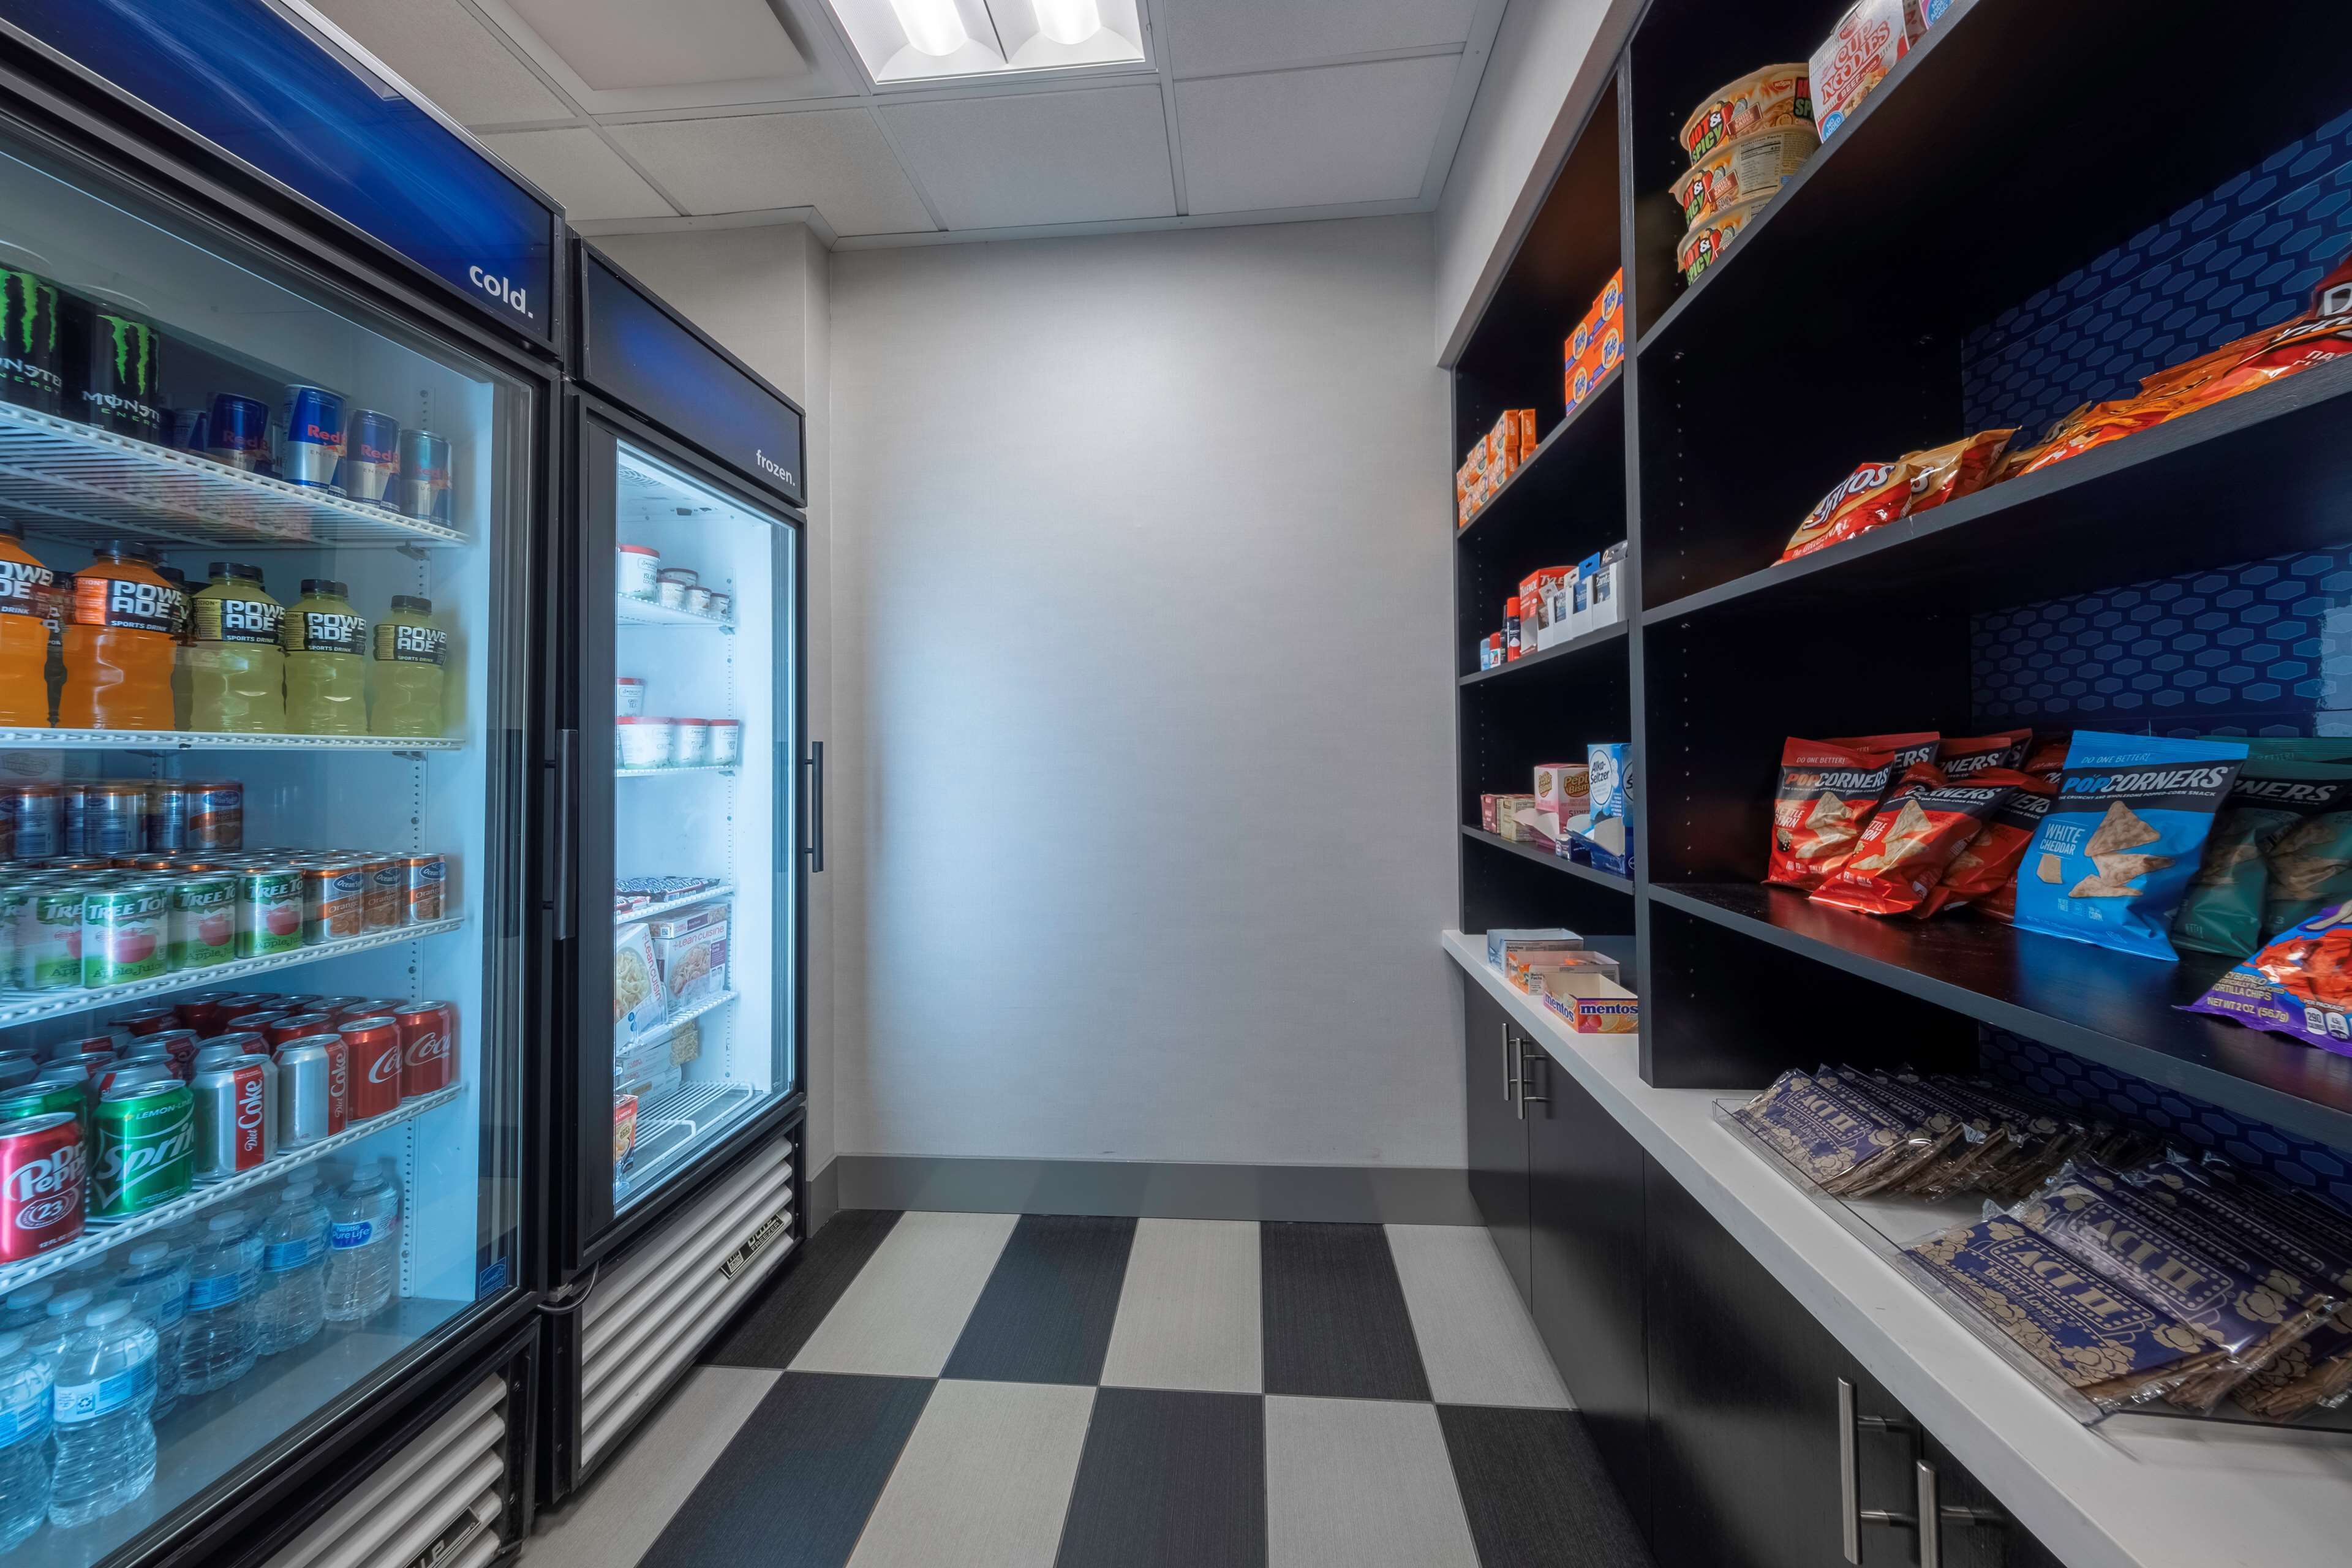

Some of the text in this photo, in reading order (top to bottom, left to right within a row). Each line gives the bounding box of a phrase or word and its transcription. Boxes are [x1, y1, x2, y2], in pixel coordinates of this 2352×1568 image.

[1834, 19, 1872, 69] CUP
[1822, 20, 1890, 105] NOODLES
[1841, 75, 1863, 97] BEEF
[1689, 112, 1722, 151] HOT &
[1826, 118, 1834, 129] NO
[1692, 124, 1722, 164] SPICY
[1683, 181, 1703, 211] OT &
[1700, 238, 1711, 252] &
[469, 265, 533, 318] cold.
[1604, 289, 1617, 317] Tide
[1575, 331, 1586, 355] Tide
[1604, 337, 1618, 364] Tide
[1575, 375, 1586, 398] Tide
[81, 390, 160, 423] MONST
[756, 449, 796, 486] frozen.
[1803, 465, 1896, 530] Fritos
[1540, 575, 1564, 585] TYLE
[1596, 574, 1611, 587] Zanta
[114, 579, 182, 606] POWE
[112, 596, 170, 619] ADE
[226, 599, 285, 620] POWE
[111, 620, 145, 629] SPORTS
[226, 614, 275, 631] ADE
[309, 625, 353, 641] ADE
[398, 638, 435, 652] ADE
[1592, 761, 1606, 771] Alka-
[2116, 753, 2151, 763] BETTER!
[1564, 772, 1589, 788] Pept
[1569, 783, 1589, 794] Bism
[1591, 771, 1610, 785] Seltzer
[1785, 767, 1889, 788] POPCORNERS
[2061, 766, 2229, 794] POPCORNERS
[2045, 823, 2086, 844] WHITE
[2040, 839, 2076, 856] CHEDDAR
[248, 878, 303, 899] TREE TO
[337, 880, 355, 888] Ocean
[179, 885, 236, 907] TREE TO
[328, 900, 358, 914] Orange
[44, 903, 82, 919] TRE
[89, 903, 135, 919] TREE
[698, 925, 725, 940] cuisine
[51, 967, 81, 978] App
[93, 963, 133, 981] Apple
[650, 968, 662, 1001] cuisin
[2245, 988, 2272, 1001] CHIPS
[1545, 994, 1575, 1023] mentos
[1580, 1003, 1638, 1015] mentos
[2207, 997, 2289, 1023] NET WT 2 OZ (56.7g)
[2307, 1011, 2322, 1023] 290
[330, 1052, 347, 1118] Diet Coke
[135, 1097, 193, 1120] LEMON-LIM
[238, 1079, 263, 1152] Diet Coke
[1798, 1094, 1859, 1133] ACT II
[1782, 1112, 1822, 1144] Butter Lovers
[96, 1122, 195, 1181] Sprit
[37, 1200, 64, 1220] 23
[332, 1228, 370, 1240] Pure Life
[751, 1221, 780, 1251] FREEZER
[2091, 1218, 2207, 1295] ACT II
[1983, 1267, 2067, 1324] Butter Lovers
[2008, 1250, 2127, 1324] ACT II
